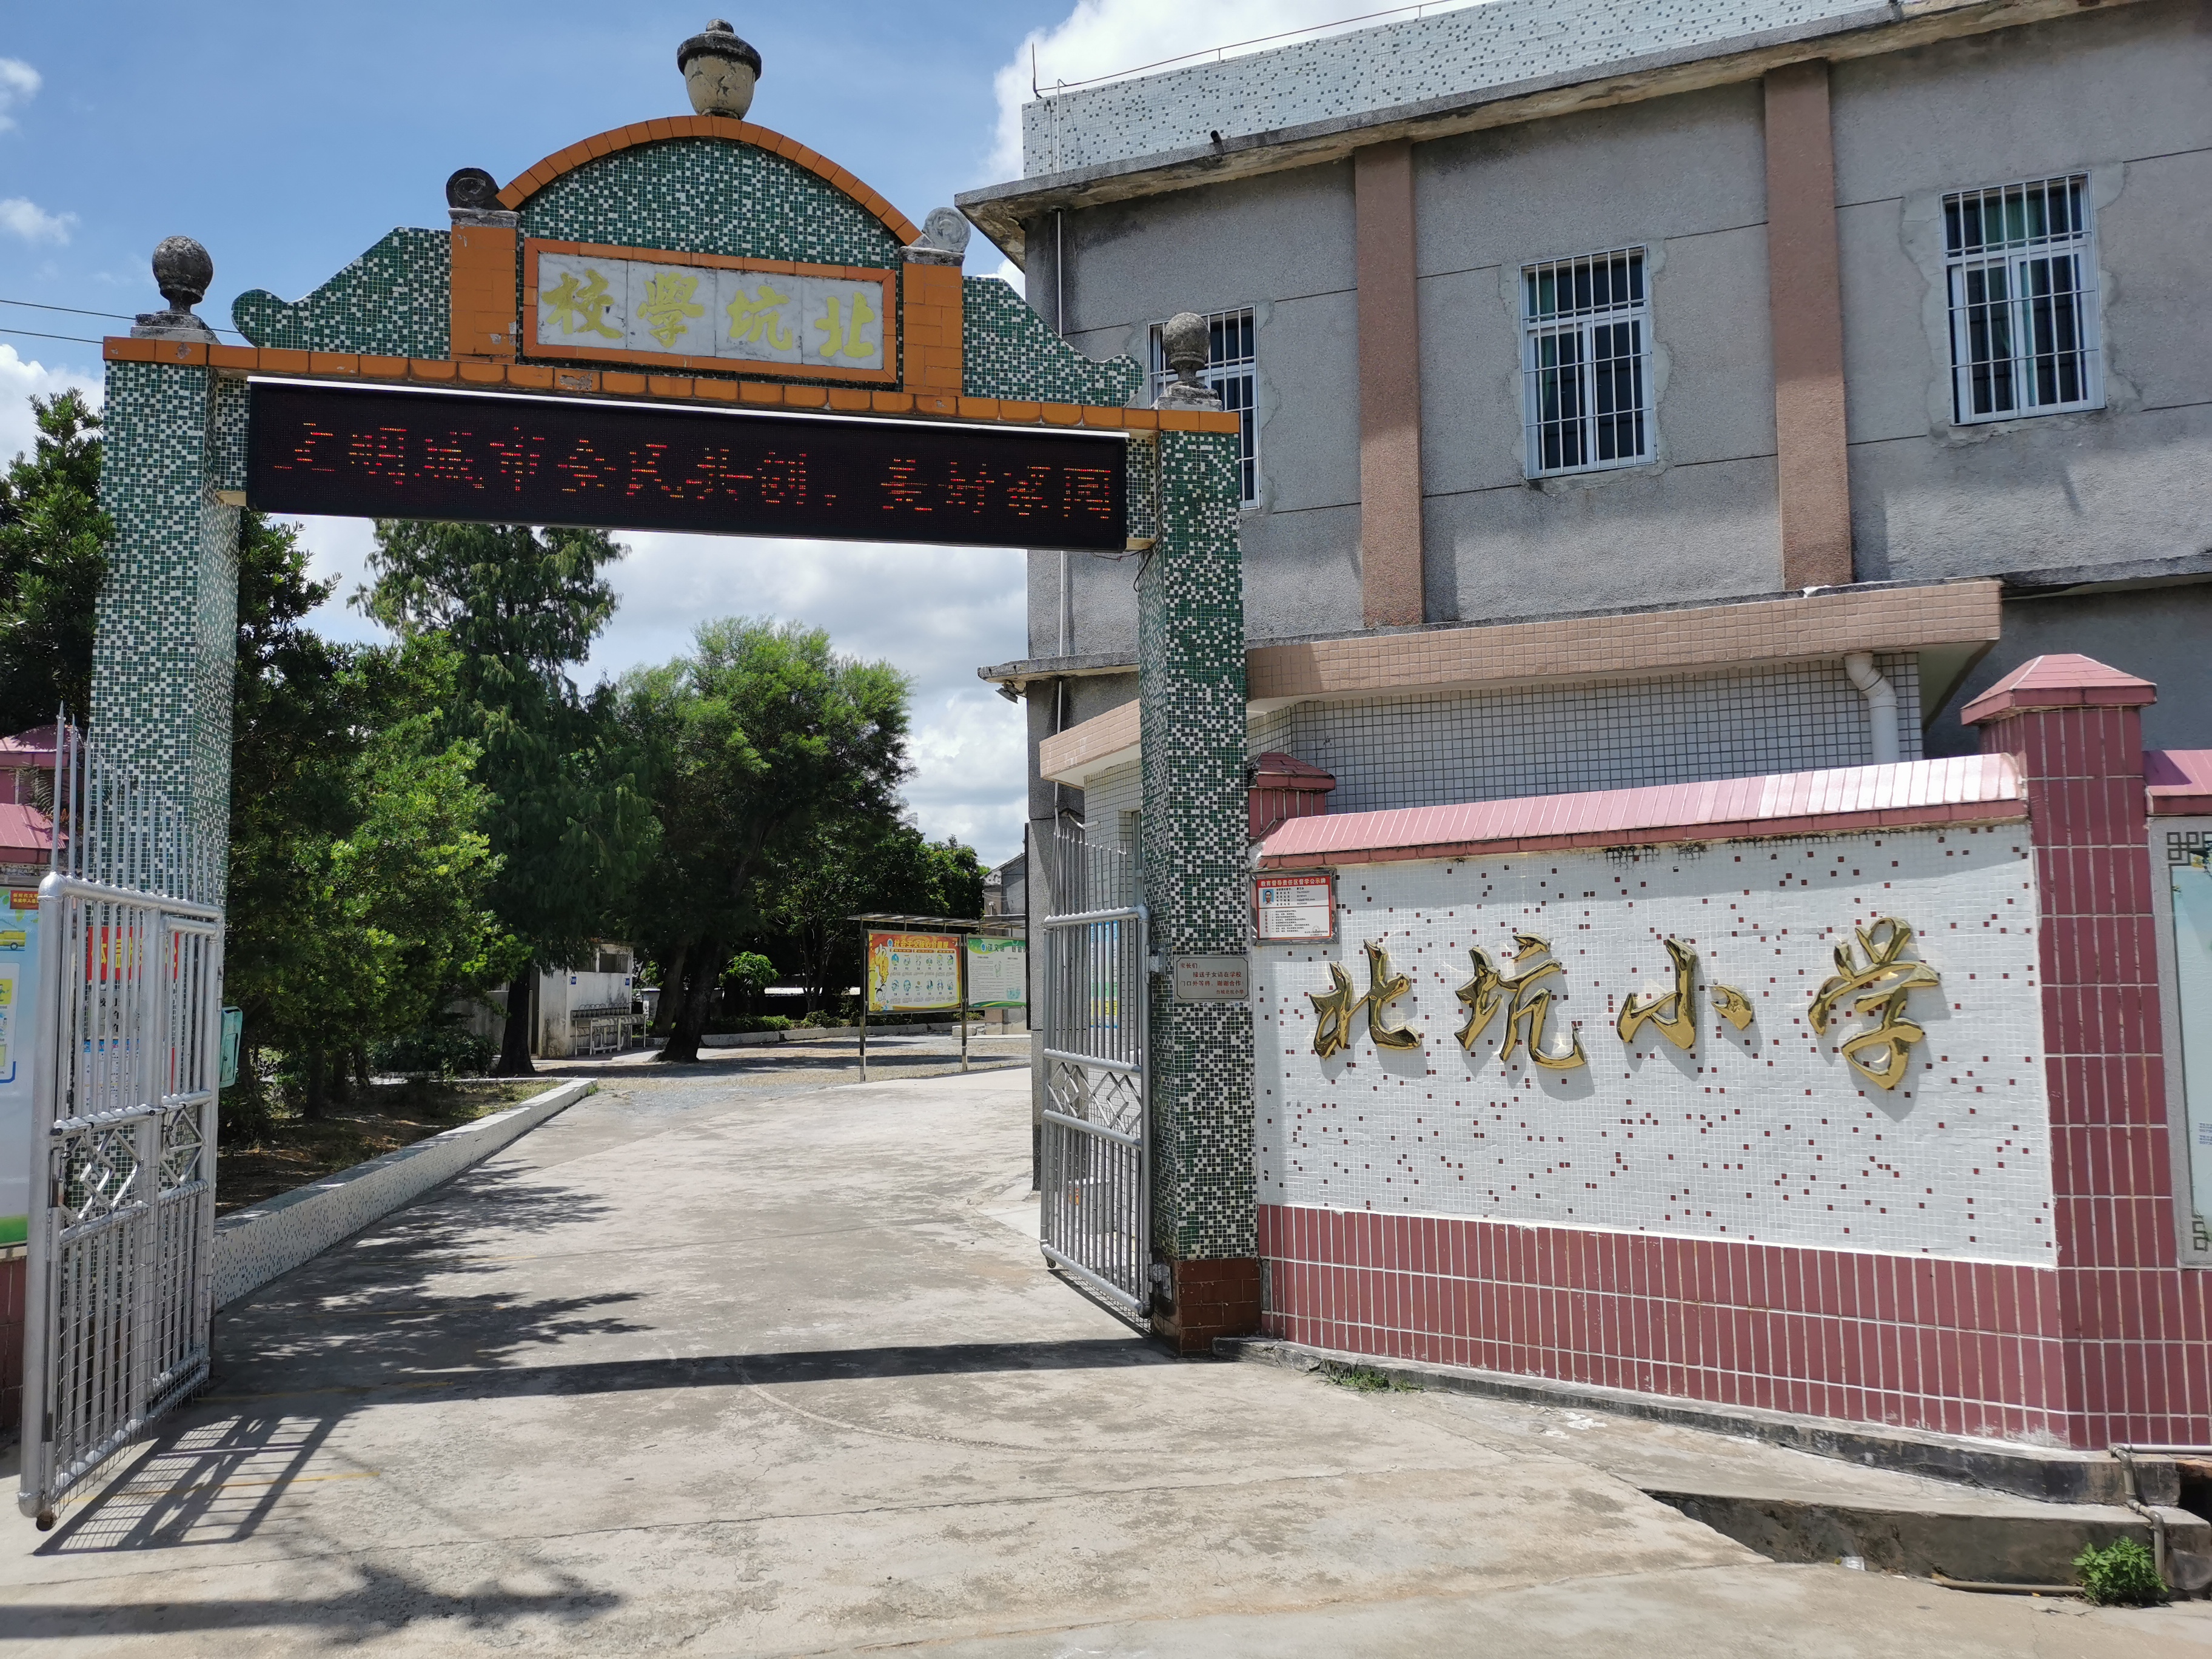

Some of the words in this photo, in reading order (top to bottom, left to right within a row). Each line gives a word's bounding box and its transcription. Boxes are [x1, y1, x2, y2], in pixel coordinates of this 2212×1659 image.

[541, 269, 875, 358] 北坑學校
[1261, 878, 1327, 886] 教育督导责任区督学公示牌
[894, 939, 949, 948] 社会主义核心价值观
[1309, 916, 1940, 1091] 北坑小学
